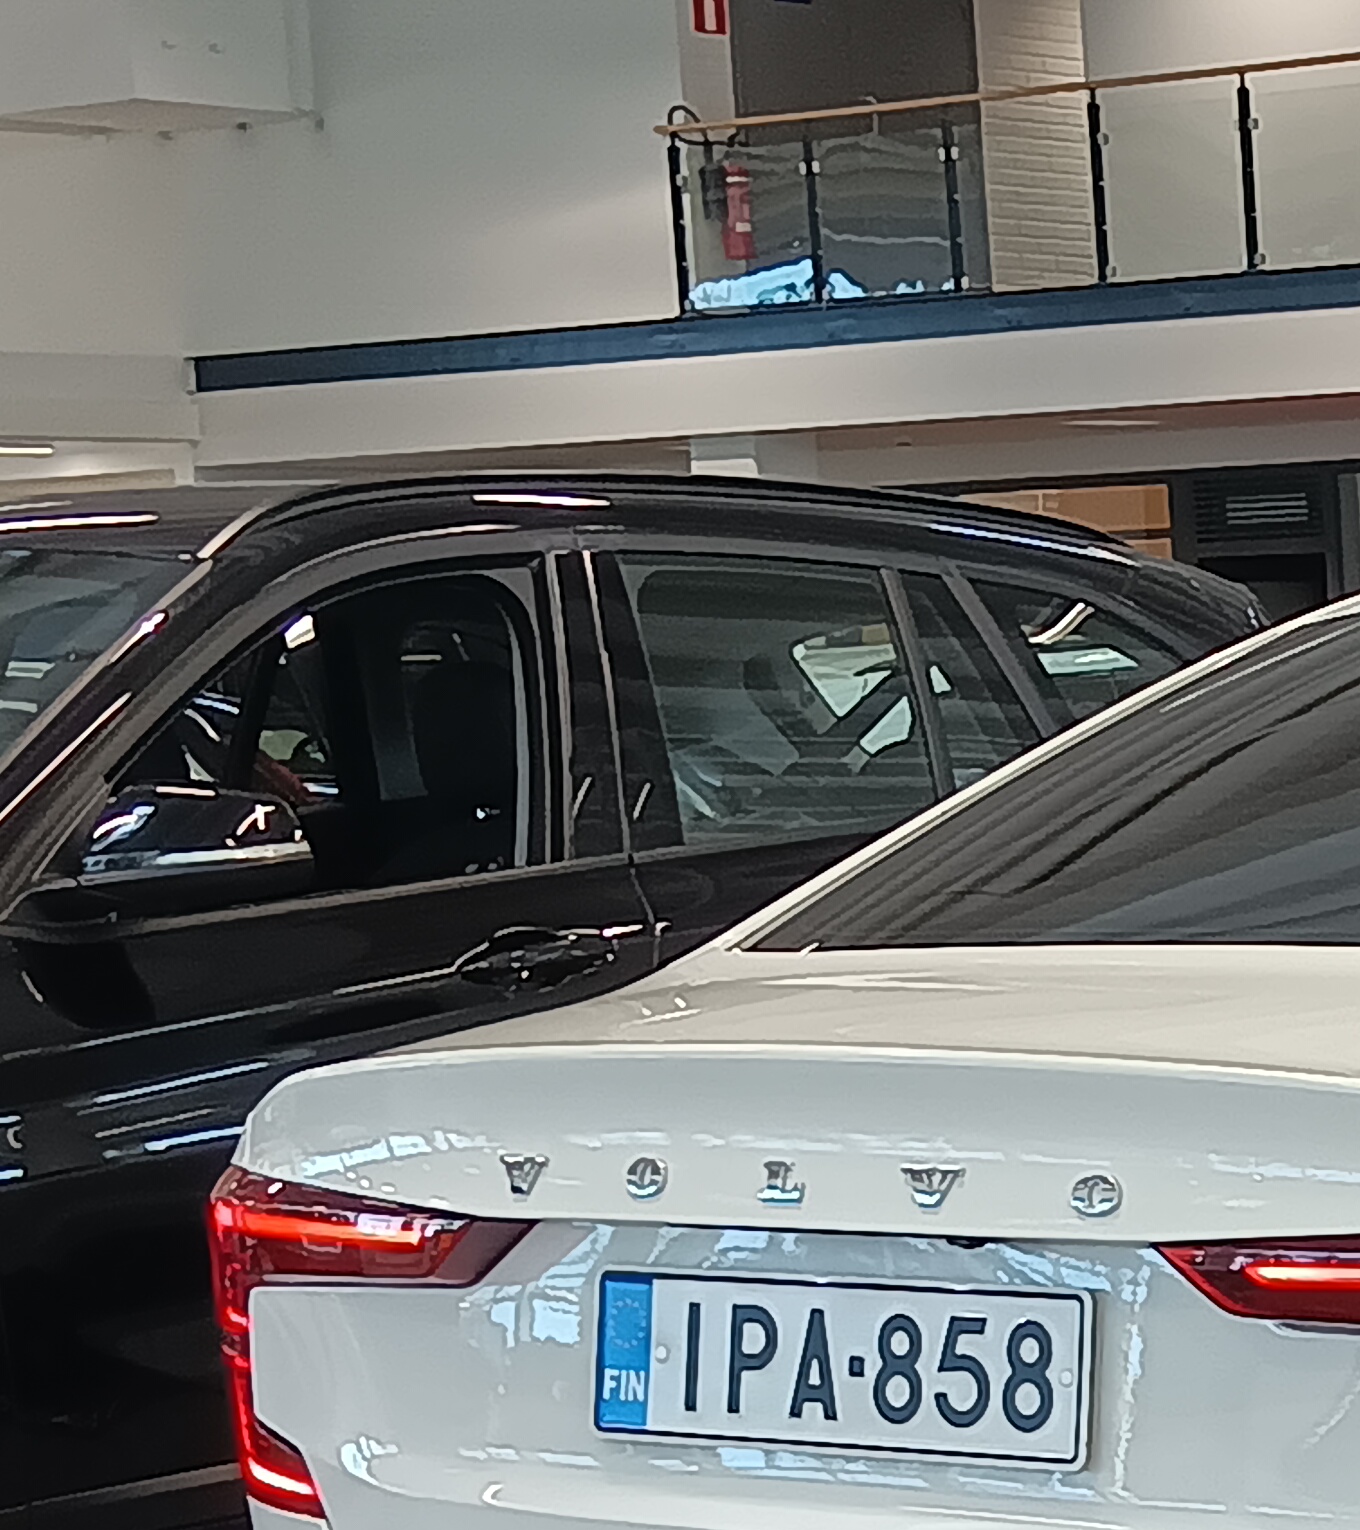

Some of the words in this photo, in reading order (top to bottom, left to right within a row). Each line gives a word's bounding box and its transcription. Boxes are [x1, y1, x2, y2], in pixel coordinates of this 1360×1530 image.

[500, 1153, 1124, 1218] VOLVO
[602, 1367, 646, 1403] FIN
[683, 1301, 1054, 1433] IPA-858
